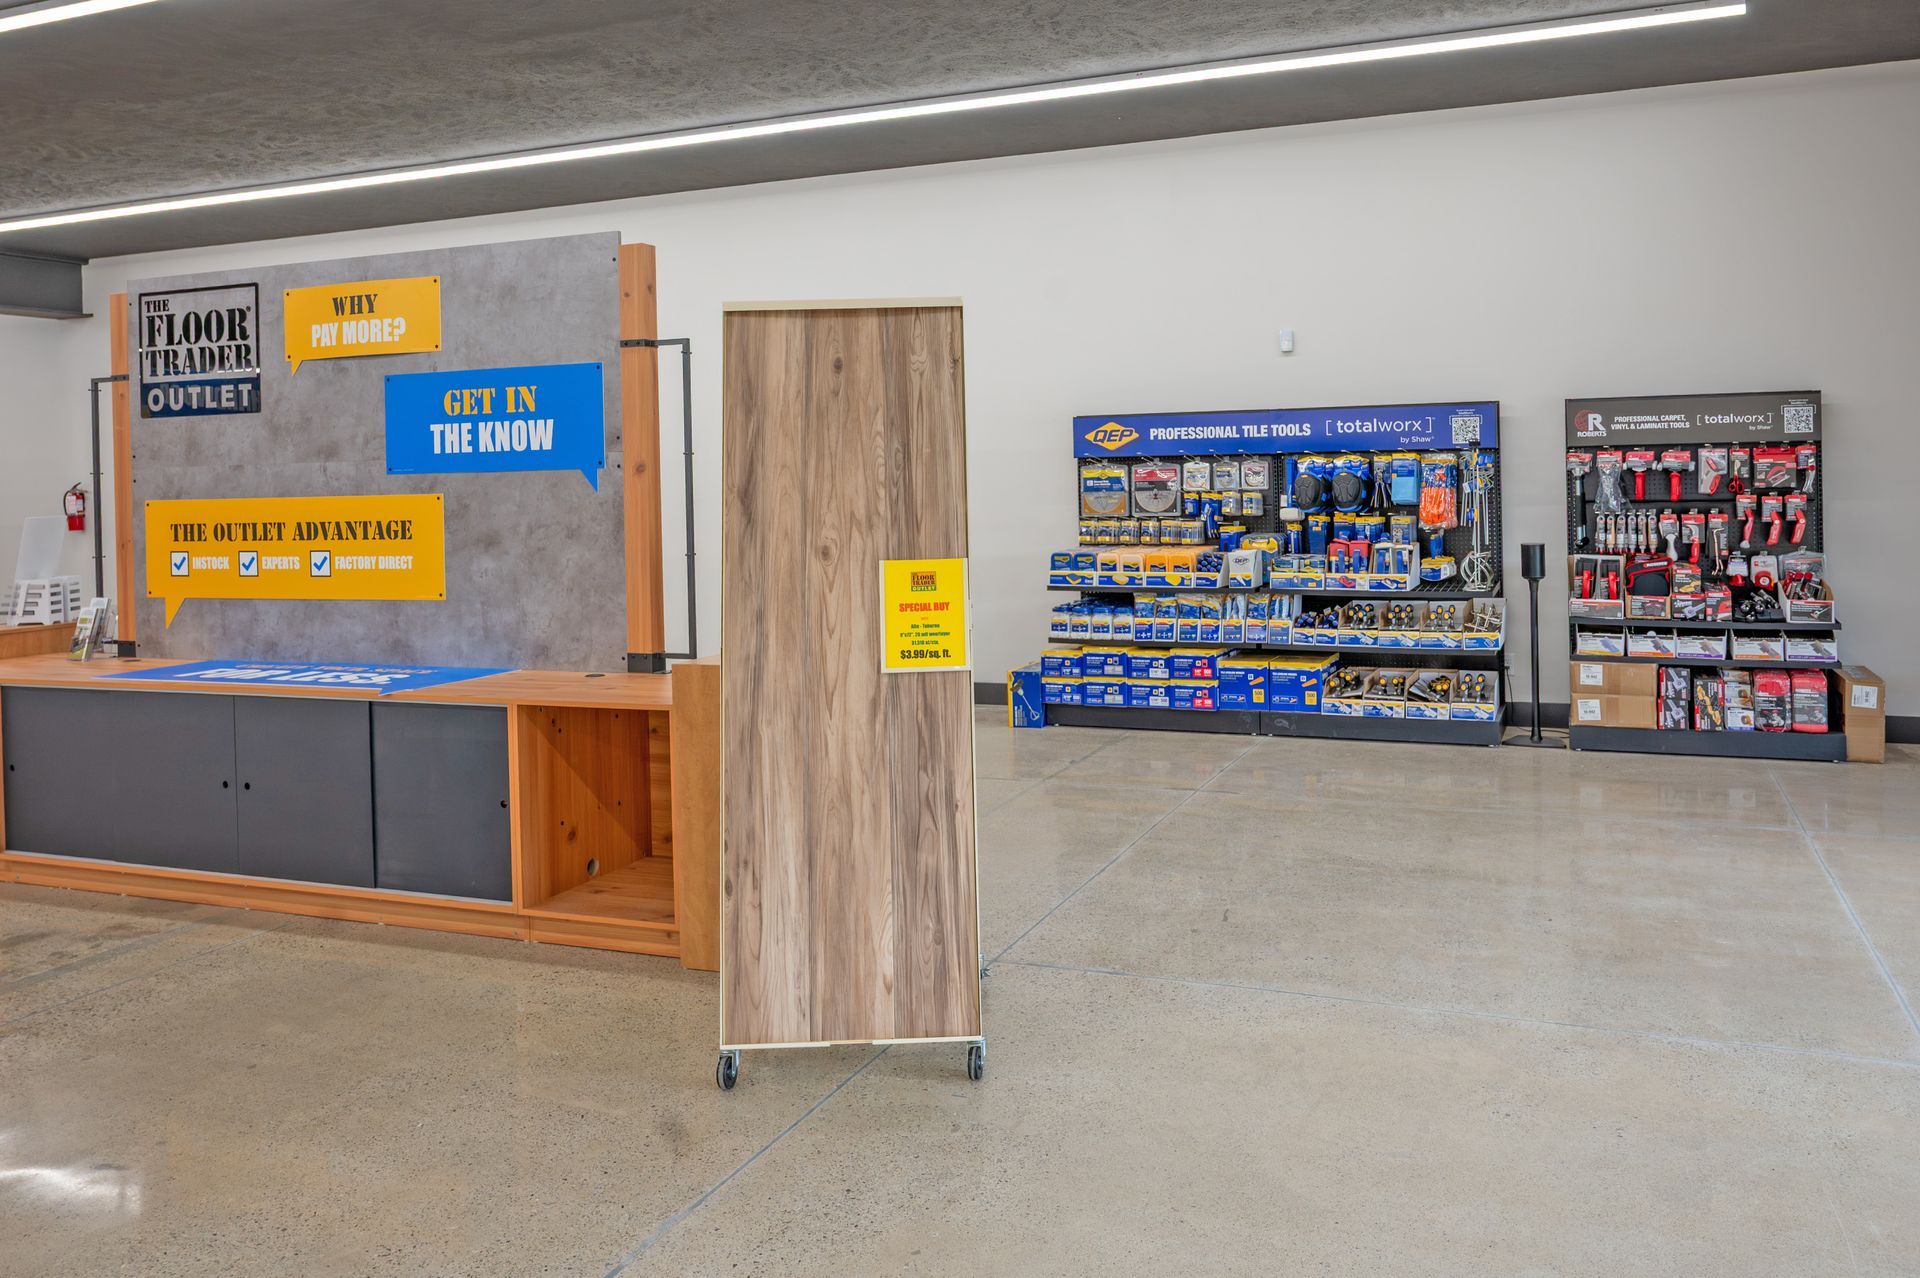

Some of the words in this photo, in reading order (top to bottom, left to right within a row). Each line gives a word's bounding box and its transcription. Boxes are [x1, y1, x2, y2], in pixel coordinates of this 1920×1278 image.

[144, 299, 170, 313] THE
[332, 293, 378, 317] WHY
[145, 308, 250, 347] FLOOR
[311, 323, 338, 348] PAY
[342, 317, 406, 345] MORE?
[145, 344, 254, 377] TRADER
[147, 383, 253, 412] OUTLET
[443, 388, 495, 416] GET
[505, 385, 537, 413] IN
[1636, 422, 1669, 430] LAMINATE
[1670, 421, 1690, 429] TOOLS
[1660, 414, 1686, 422] CARPET,
[430, 422, 472, 454] THE
[478, 419, 554, 453] KNOW
[1092, 429, 1134, 443] QEP
[1150, 426, 1239, 440] PROFESSIONAL
[1242, 425, 1269, 438] TILE
[1271, 423, 1311, 437] TOOLS
[1400, 436, 1409, 444] by
[170, 523, 207, 542] THE
[213, 522, 286, 542] OUTLET
[292, 519, 413, 541] ADVANTAGE
[192, 556, 230, 570] INSTOCK
[262, 555, 300, 570] EXPERTS
[334, 555, 377, 570] FACTORY
[378, 555, 413, 570] DIRECT
[899, 602, 932, 613] SPECIAL
[933, 601, 950, 611] BUY
